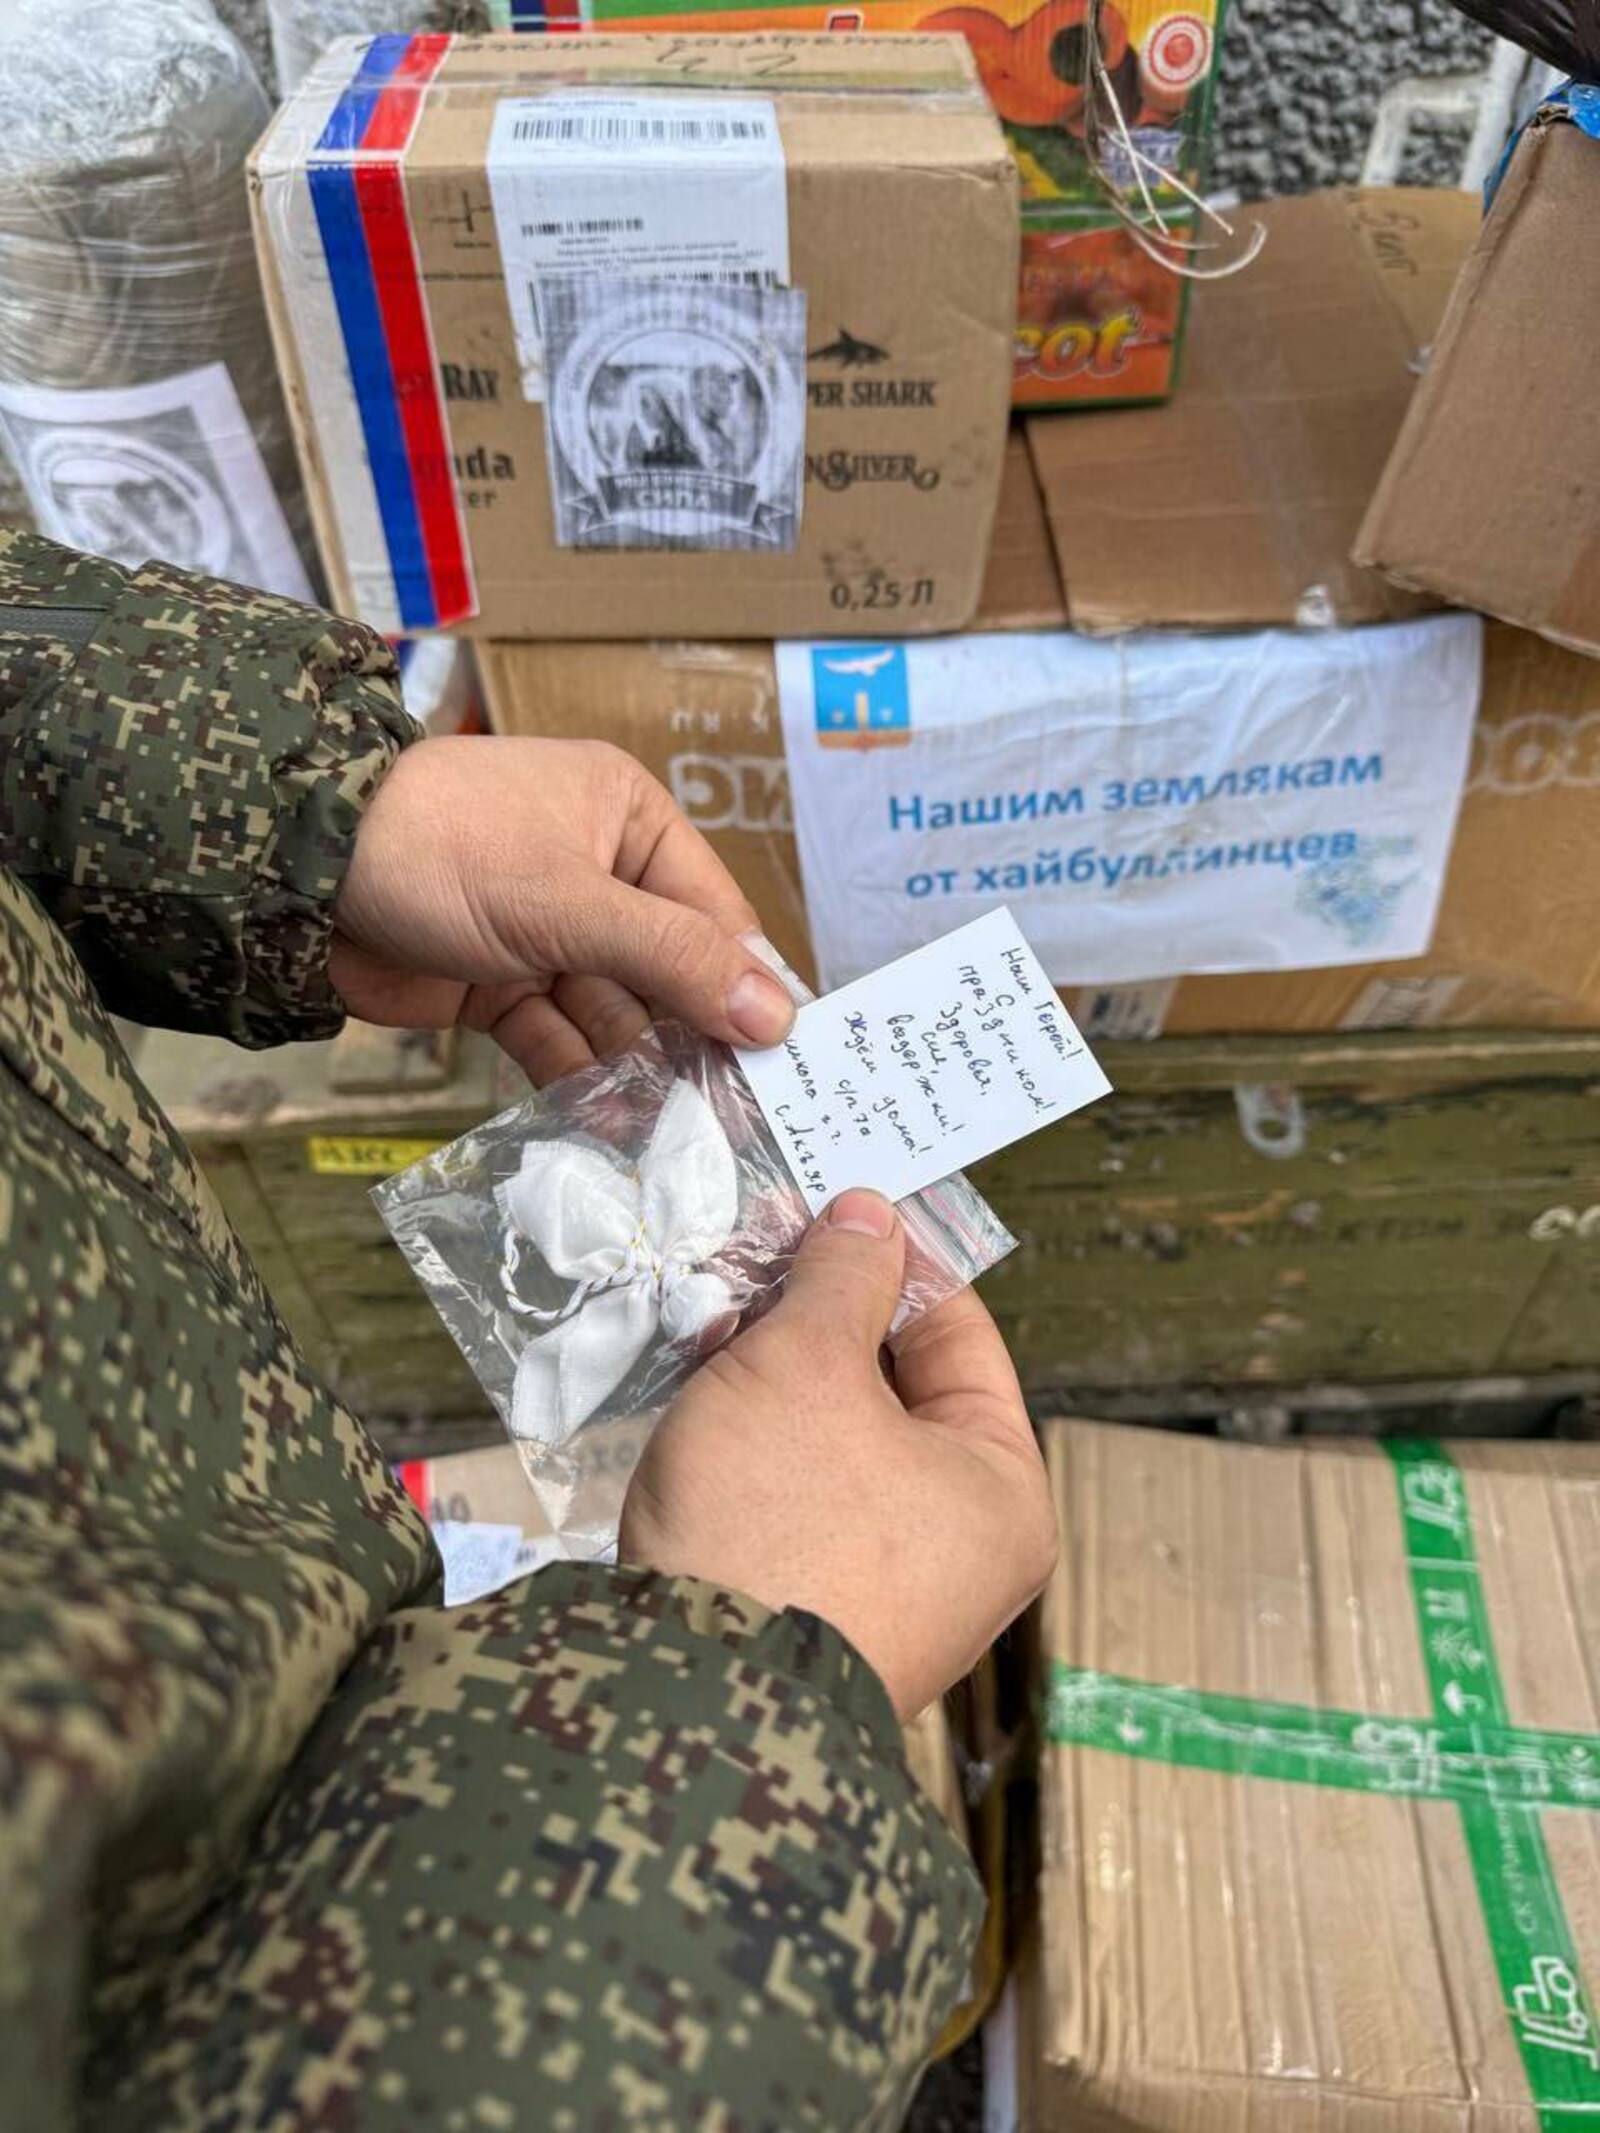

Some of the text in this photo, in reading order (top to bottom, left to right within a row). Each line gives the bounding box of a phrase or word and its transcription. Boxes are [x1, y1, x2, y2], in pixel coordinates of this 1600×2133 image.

[806, 379, 937, 408] ER SHARK
[829, 580, 902, 613] 0,25
[888, 752, 1386, 832] Нашим землякам
[904, 828, 1358, 900] от хайбуллинцев
[959, 964, 1058, 1115] праздником!
